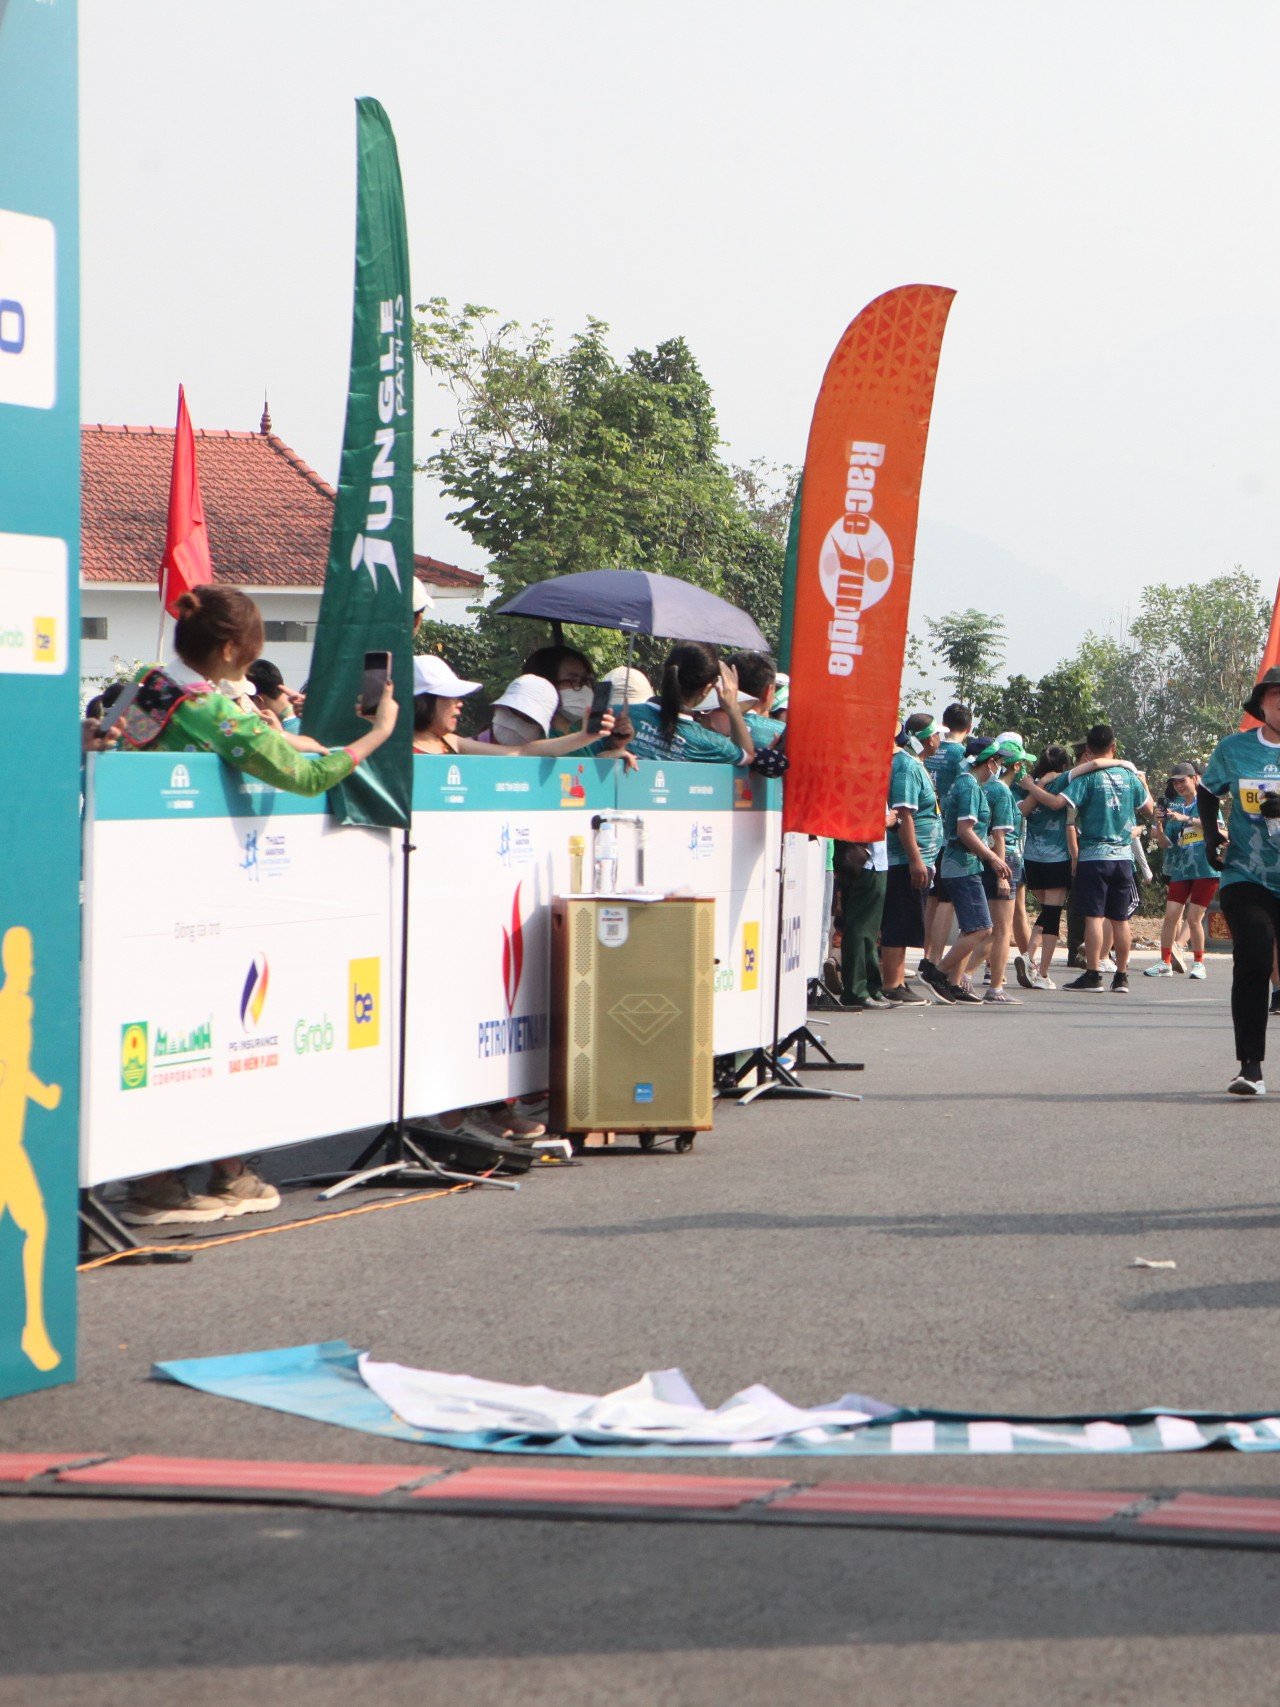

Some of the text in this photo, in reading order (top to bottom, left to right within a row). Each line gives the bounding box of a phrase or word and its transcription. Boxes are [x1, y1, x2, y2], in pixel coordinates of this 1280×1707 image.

[351, 299, 402, 594] JUNGLE
[843, 440, 887, 536] Race
[294, 1013, 334, 1055] Grab
[354, 982, 373, 1024] be
